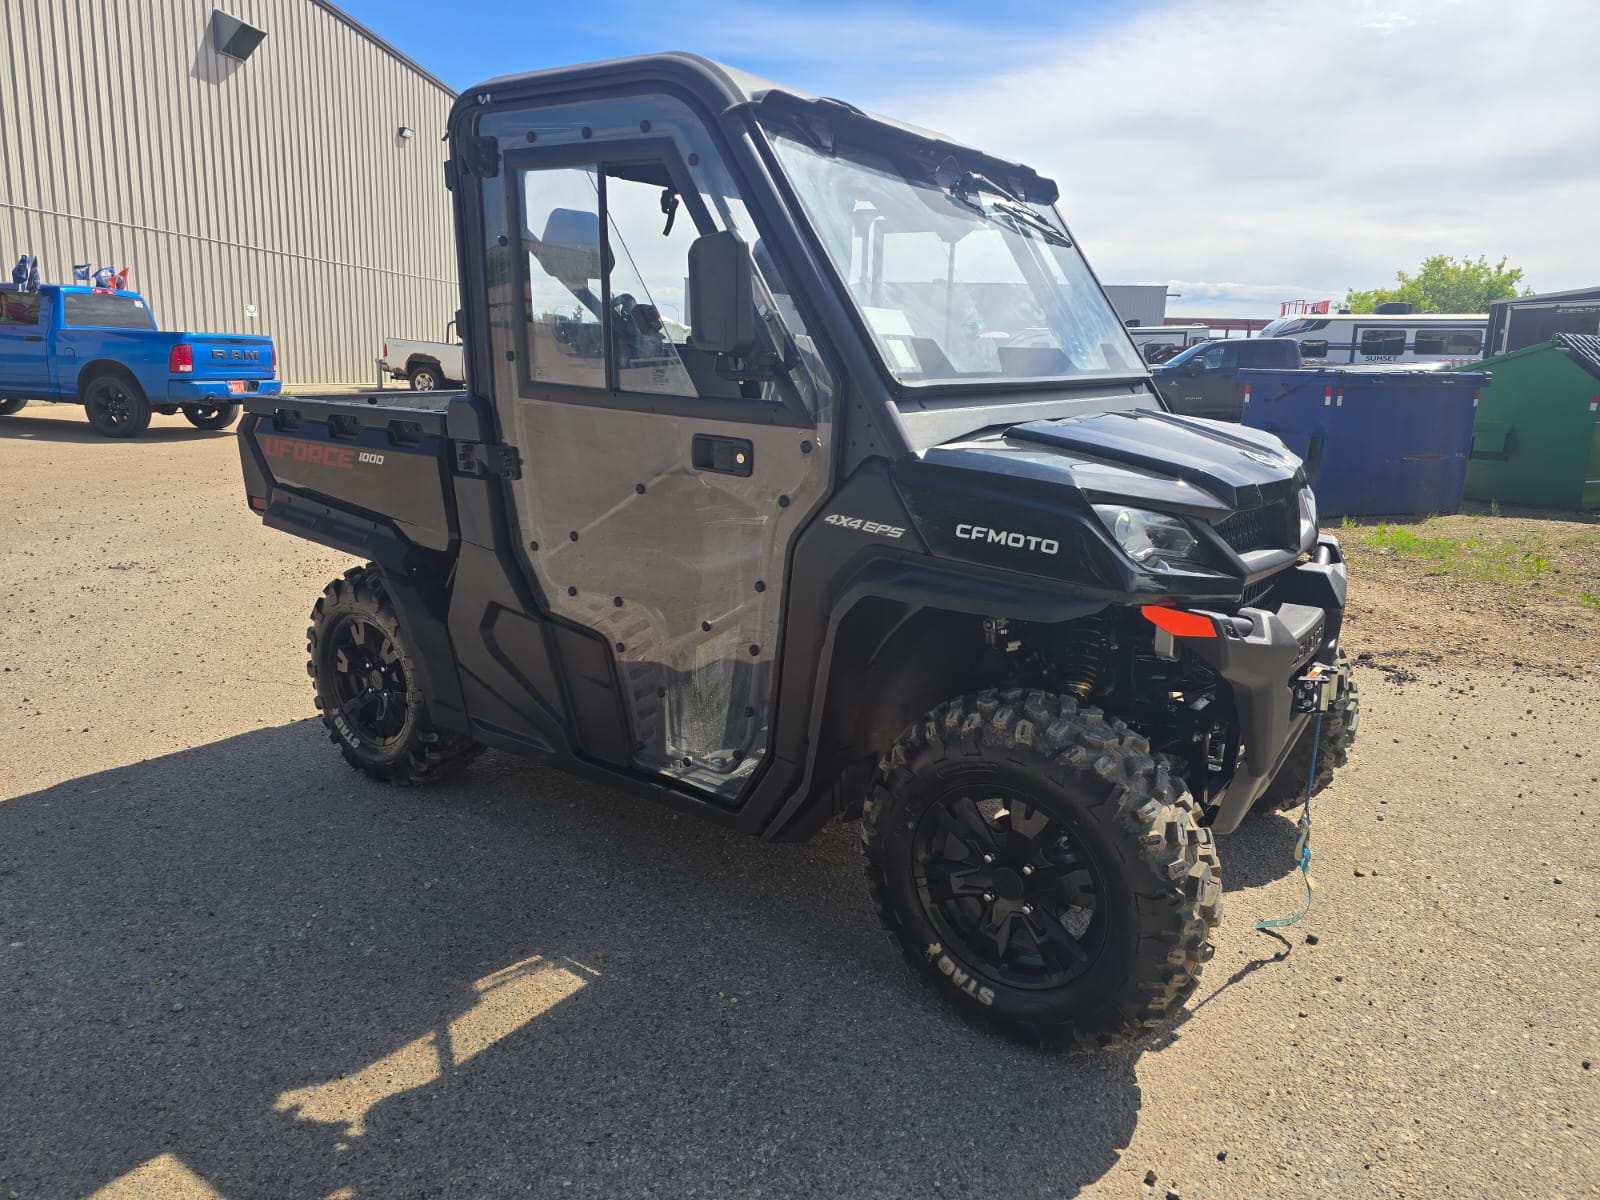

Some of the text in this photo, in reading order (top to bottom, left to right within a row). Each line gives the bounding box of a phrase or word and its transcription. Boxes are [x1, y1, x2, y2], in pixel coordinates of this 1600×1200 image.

[211, 349, 259, 361] RAM
[264, 437, 384, 469] UFORCE 1000
[862, 521, 906, 538] EPS
[955, 523, 1059, 554] CFMOTO
[334, 715, 360, 748] STAG
[937, 954, 995, 1006] STAG
